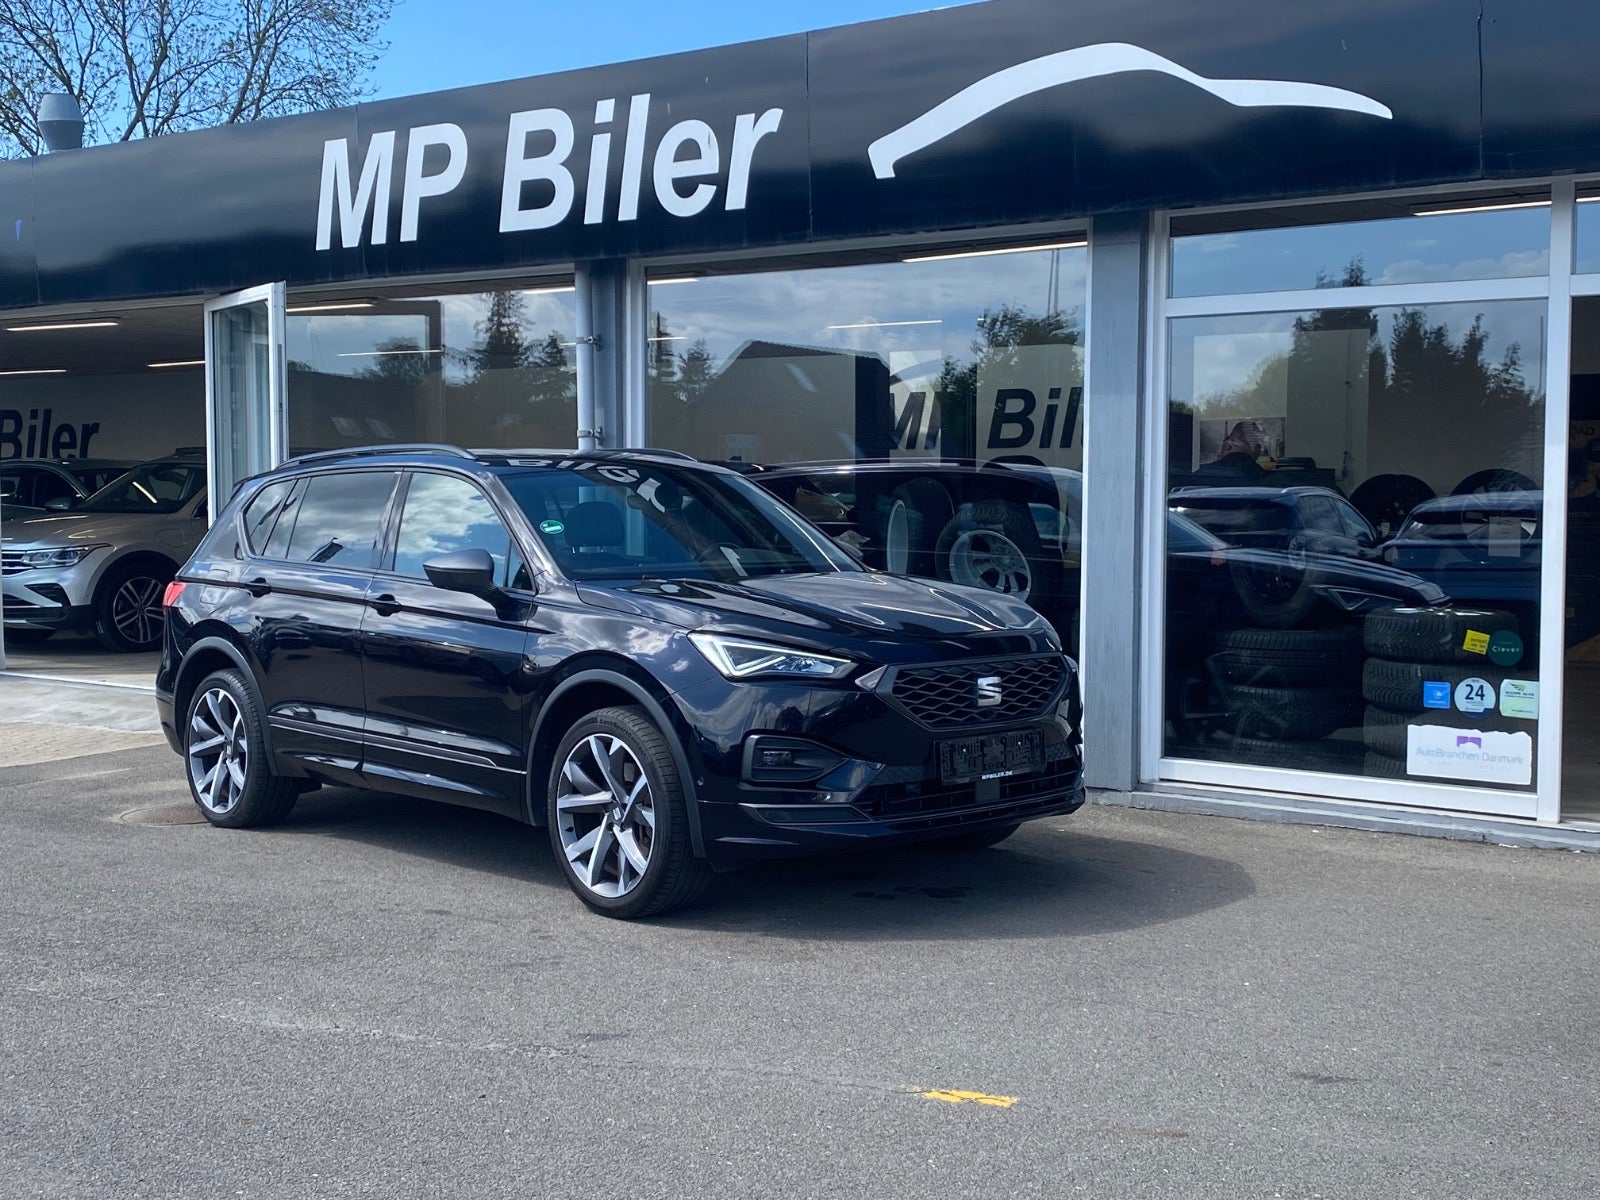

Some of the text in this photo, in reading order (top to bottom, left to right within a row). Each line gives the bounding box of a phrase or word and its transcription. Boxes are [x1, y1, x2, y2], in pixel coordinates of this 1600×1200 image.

[315, 93, 784, 251] MP Biler
[0, 408, 100, 459] Biler
[987, 387, 1084, 449] Bil
[1491, 645, 1521, 653] Clever
[1464, 683, 1486, 701] 24
[1415, 746, 1524, 765] AutoBranchen Danmark
